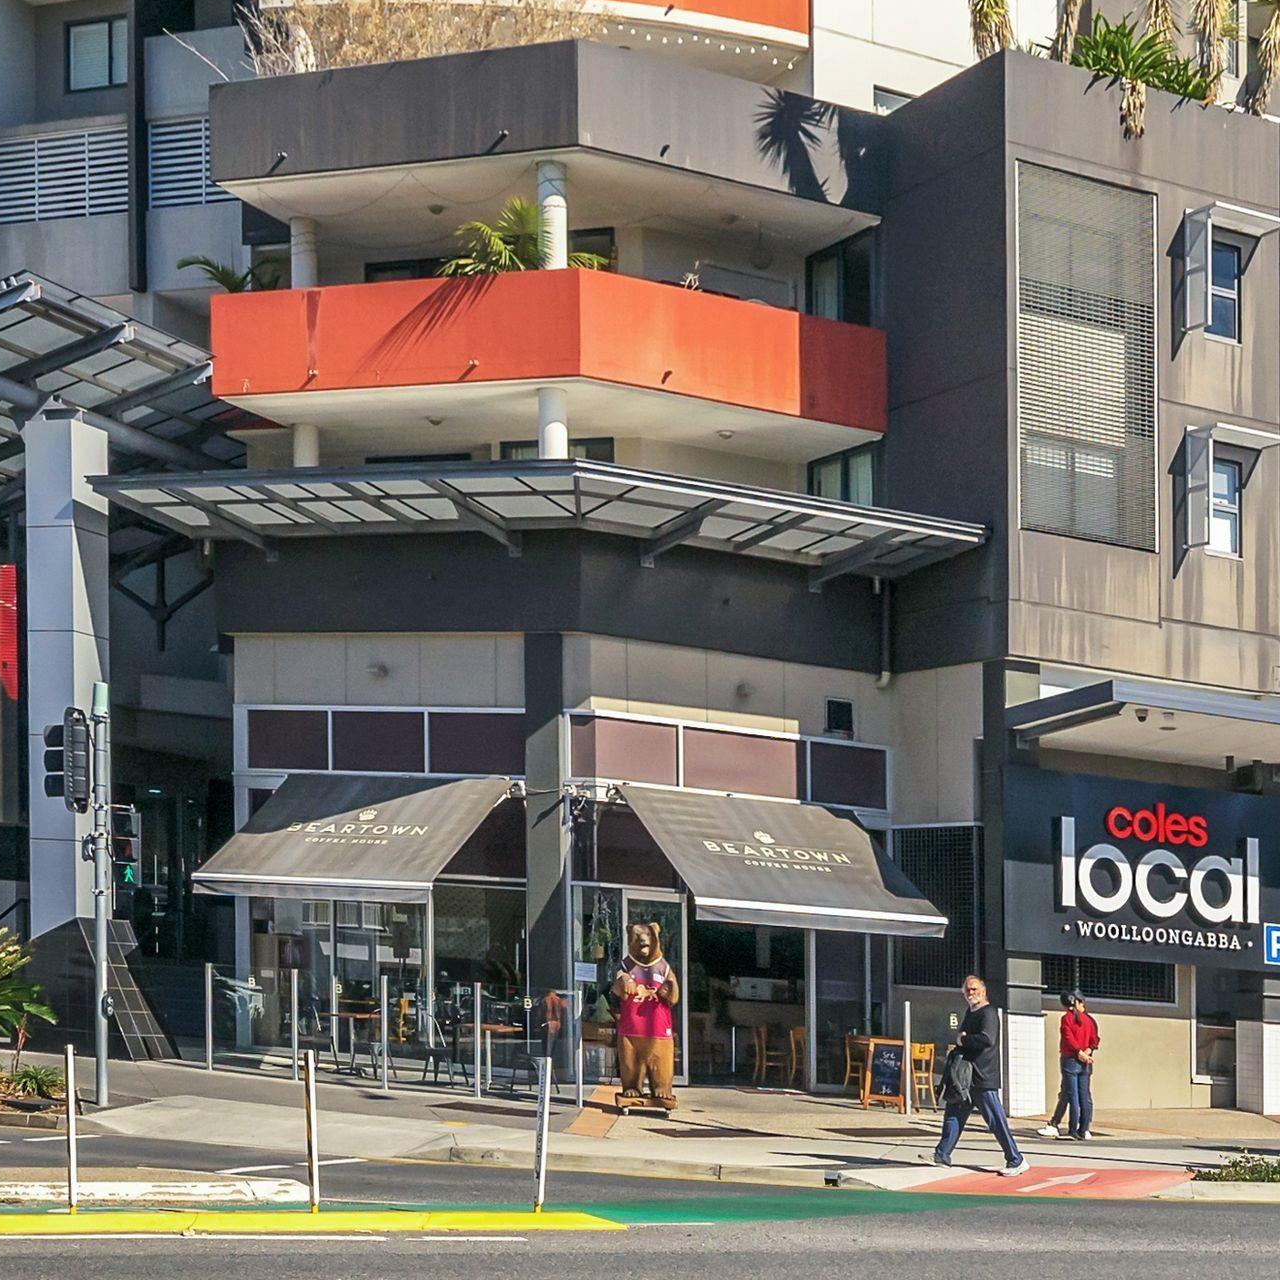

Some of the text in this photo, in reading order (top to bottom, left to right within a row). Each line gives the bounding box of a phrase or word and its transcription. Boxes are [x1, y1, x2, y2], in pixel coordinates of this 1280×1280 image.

[286, 821, 429, 837] BEARTOWN
[1106, 801, 1209, 848] coles
[702, 840, 852, 865] BEARTOWN
[1060, 815, 1260, 925] local
[1076, 919, 1242, 951] WOOLLOONGABBA
